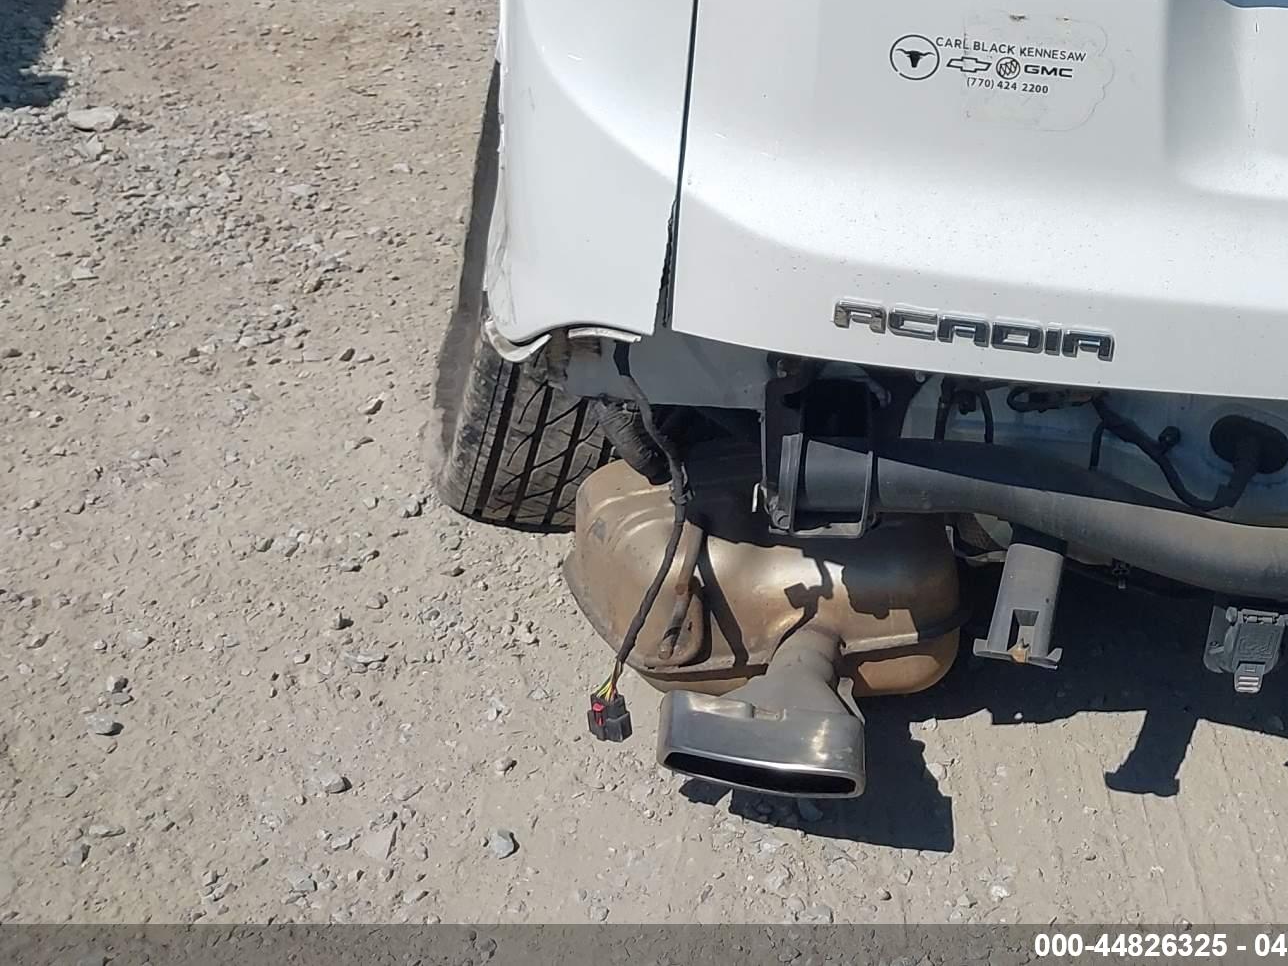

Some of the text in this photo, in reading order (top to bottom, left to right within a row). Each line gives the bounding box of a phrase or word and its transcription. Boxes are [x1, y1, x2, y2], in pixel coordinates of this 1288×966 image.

[935, 36, 1087, 62] CARL BLACK KENNESAW
[1023, 64, 1073, 78] GMC
[966, 76, 1049, 94] (770) 424 2200
[834, 297, 1115, 363] ACADIA
